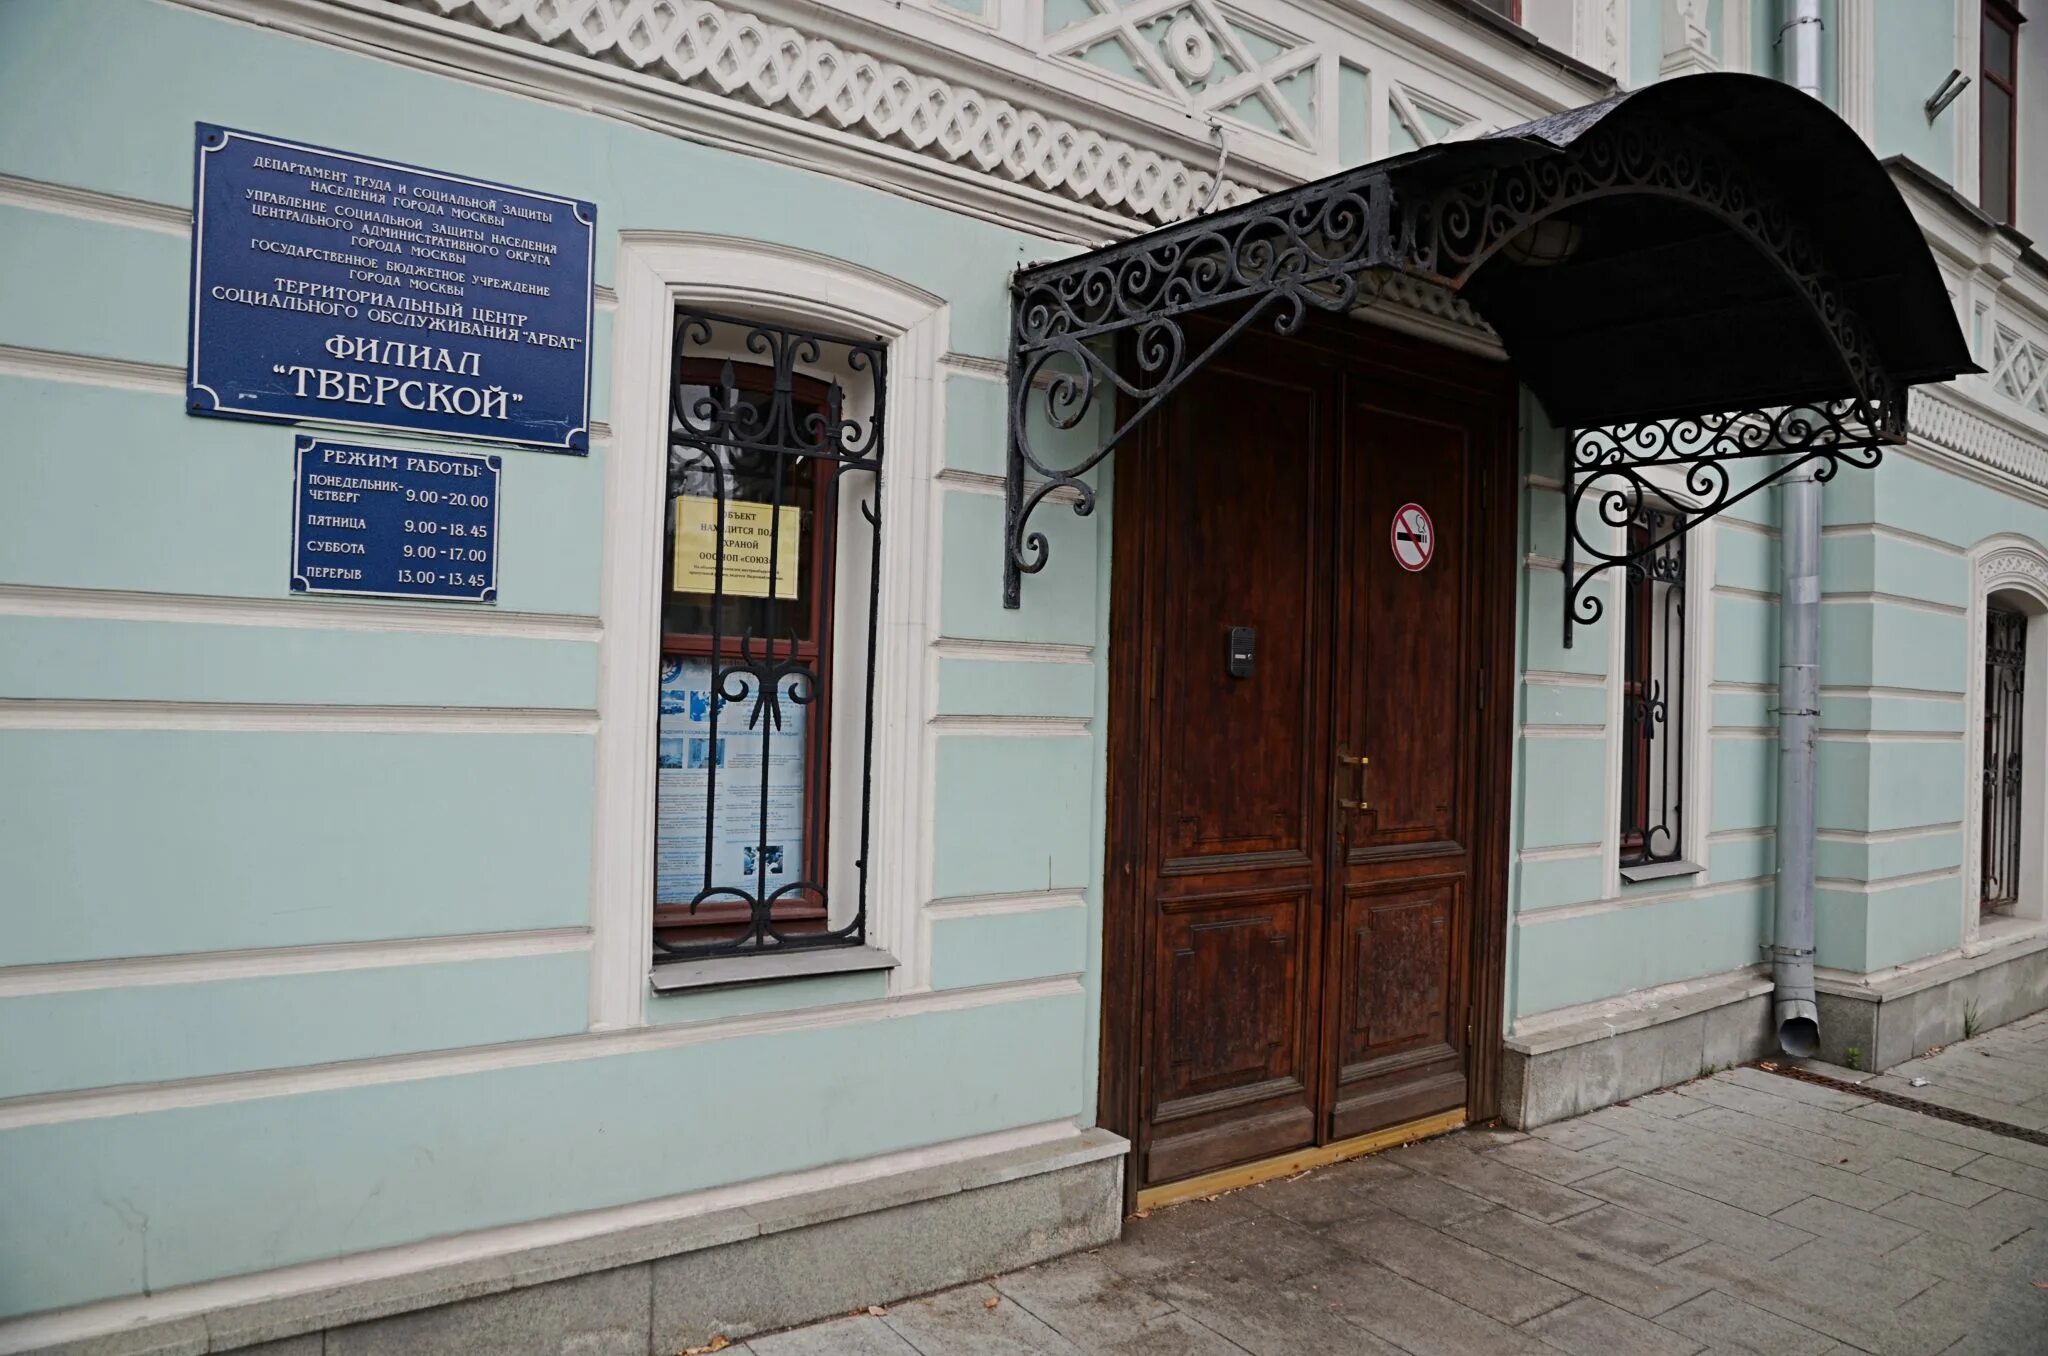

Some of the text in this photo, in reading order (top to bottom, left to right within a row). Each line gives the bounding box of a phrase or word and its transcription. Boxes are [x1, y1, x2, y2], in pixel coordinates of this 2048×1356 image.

[253, 156, 552, 223] ДЕПАРТАМЕНТ ТРУДА И СОЦИАЛЬНОЙ ЗАЩИТЫ
[311, 181, 504, 226] НАСЕЛЕНИЯ ГОРОДА МОСКВЫ
[246, 189, 557, 254] УПРАВЛЕНИЕ СОЦИАЛЬНОЙ ЗАЩИТЫ НАСЕЛЕНИЯ
[252, 204, 551, 266] ЦЕНТРАЛЬНОГО АДМИНИСТРАТИВНОГО ОКРУГА
[351, 236, 466, 264] ГОРОДА МОСКВЫ
[251, 238, 550, 296] ГОСУДАРСТВЕННОЕ БЮДЖЕТНОЕ УЧРЕЖДЕНИЕ
[349, 269, 464, 296] ГОРОДА МОСКВЫ
[212, 286, 358, 318] СОЦИАЛЬНОГО
[368, 308, 519, 342] ОБСЛУЖИВАНИЯ
[274, 278, 528, 327] ТЕРРИТОРИАЛЬНЫЙ ЦЕНТР
[325, 334, 481, 376] ФИЛИАЛ
[324, 449, 482, 477] РЕЖИМ РАБОТЫ:
[309, 474, 403, 492] ПОНЕДЕЛЬНИК-
[309, 489, 360, 503] ЧЕТВЕРГ
[308, 514, 366, 529] ПЯТНИЦА
[700, 523, 773, 537] НАХДИТСЯ ПО
[307, 540, 365, 554] СУББОТА
[723, 537, 759, 550] ХРАНОЙ
[307, 566, 362, 580] ПЕРЕРЫВ
